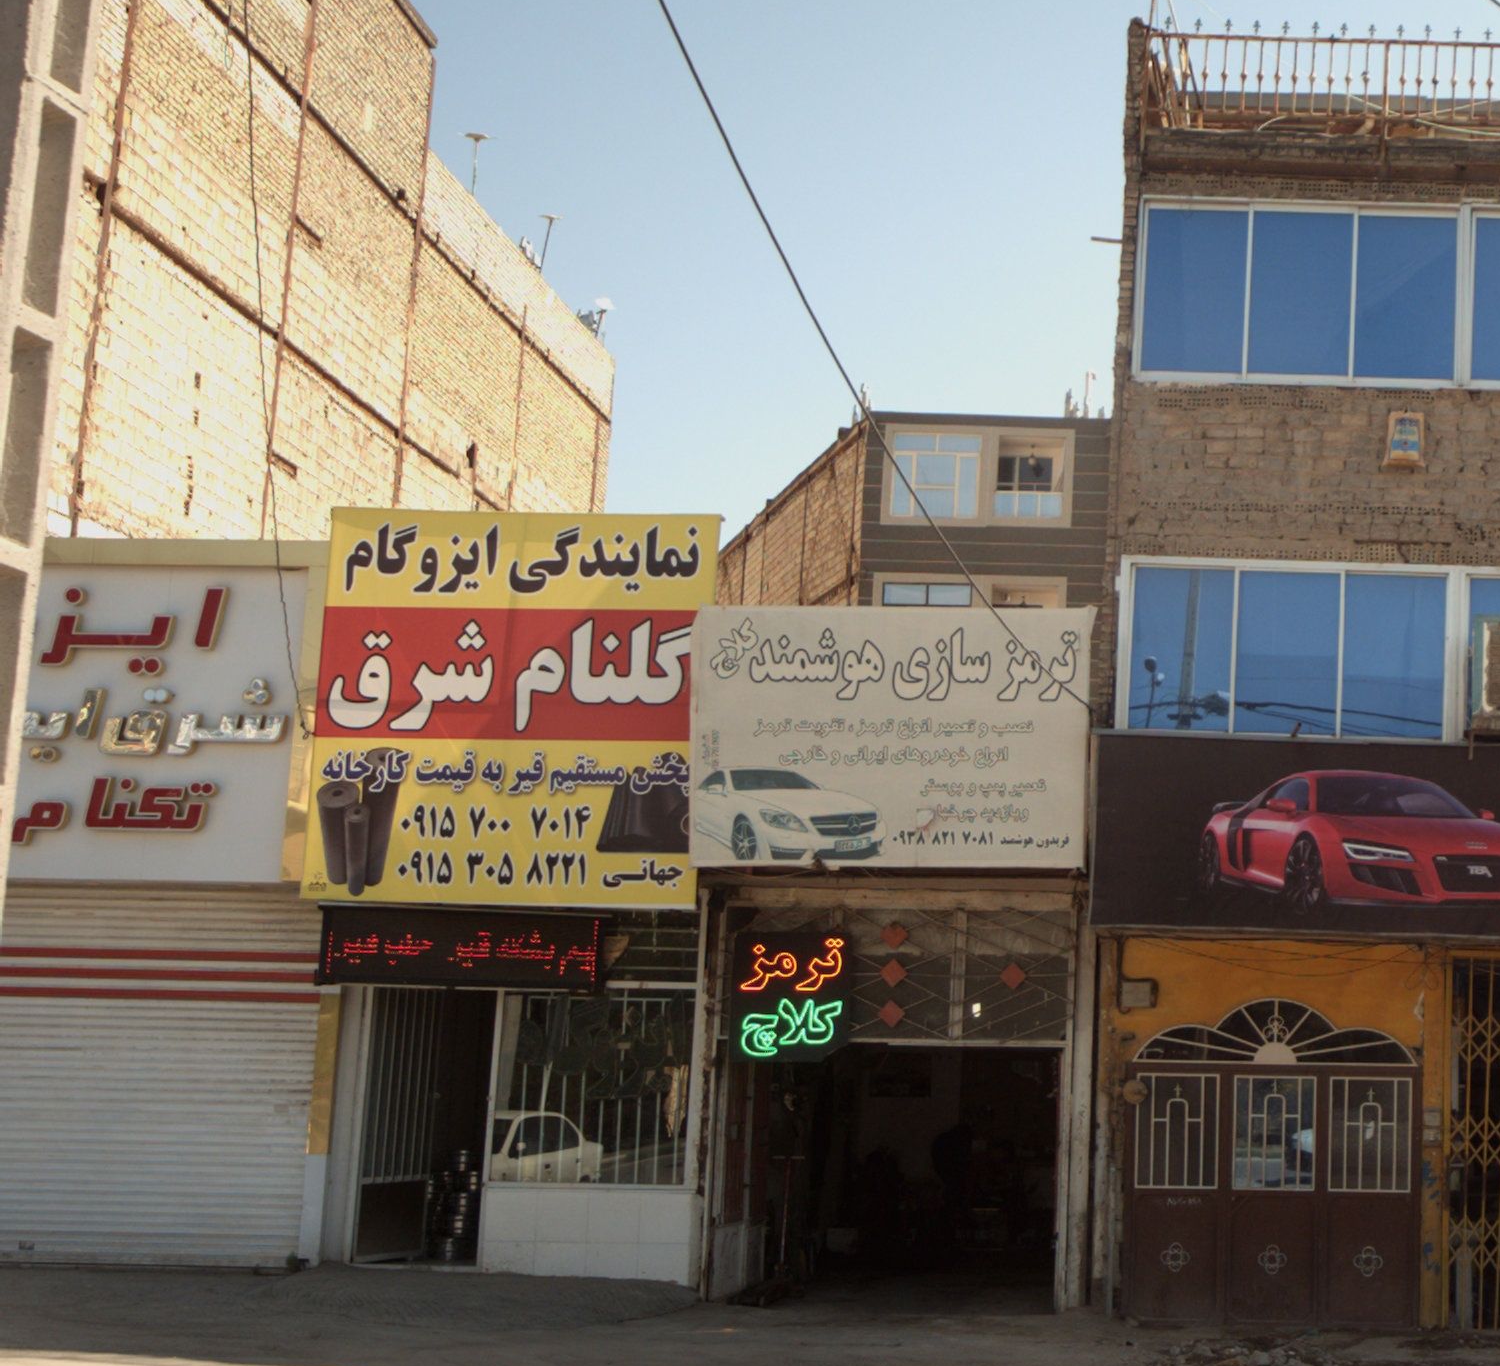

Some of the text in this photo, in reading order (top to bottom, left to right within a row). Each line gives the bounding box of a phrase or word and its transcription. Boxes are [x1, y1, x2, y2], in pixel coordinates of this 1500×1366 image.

[345, 523, 700, 593] نمایندگی ایزوگام
[709, 616, 760, 679] کلاچ
[748, 626, 1079, 702] ترمز سازی هوشمند
[326, 617, 692, 733] گلنام شرق
[99, 677, 288, 756] شرق
[753, 718, 793, 737] ترمز
[794, 718, 846, 738] تقویت
[856, 718, 895, 737] ترمز
[897, 717, 932, 740] انواع
[934, 719, 976, 737] تعمیر
[978, 722, 989, 738] و
[991, 720, 1035, 736] نصب
[415, 751, 475, 793] قیمت
[509, 752, 546, 794] قیر
[549, 753, 627, 793] مستقیم
[778, 744, 828, 767] خارجی
[830, 752, 841, 766] و
[844, 745, 888, 766] ایرانی
[974, 745, 1009, 769] انواع
[480, 757, 504, 792] به
[11, 776, 217, 844] تکنام
[400, 804, 592, 839] ۰۹۱۵ ۷۰۰ ۷۰۱۴
[931, 831, 956, 845] ۸۲۱
[962, 830, 994, 845] ۷۰۸۱
[397, 850, 683, 888] ۰۹۱۵ ۳۰۵ ۸۲۲۱ جهانی
[740, 937, 845, 991] ترمز
[741, 998, 843, 1057] کلاچ
